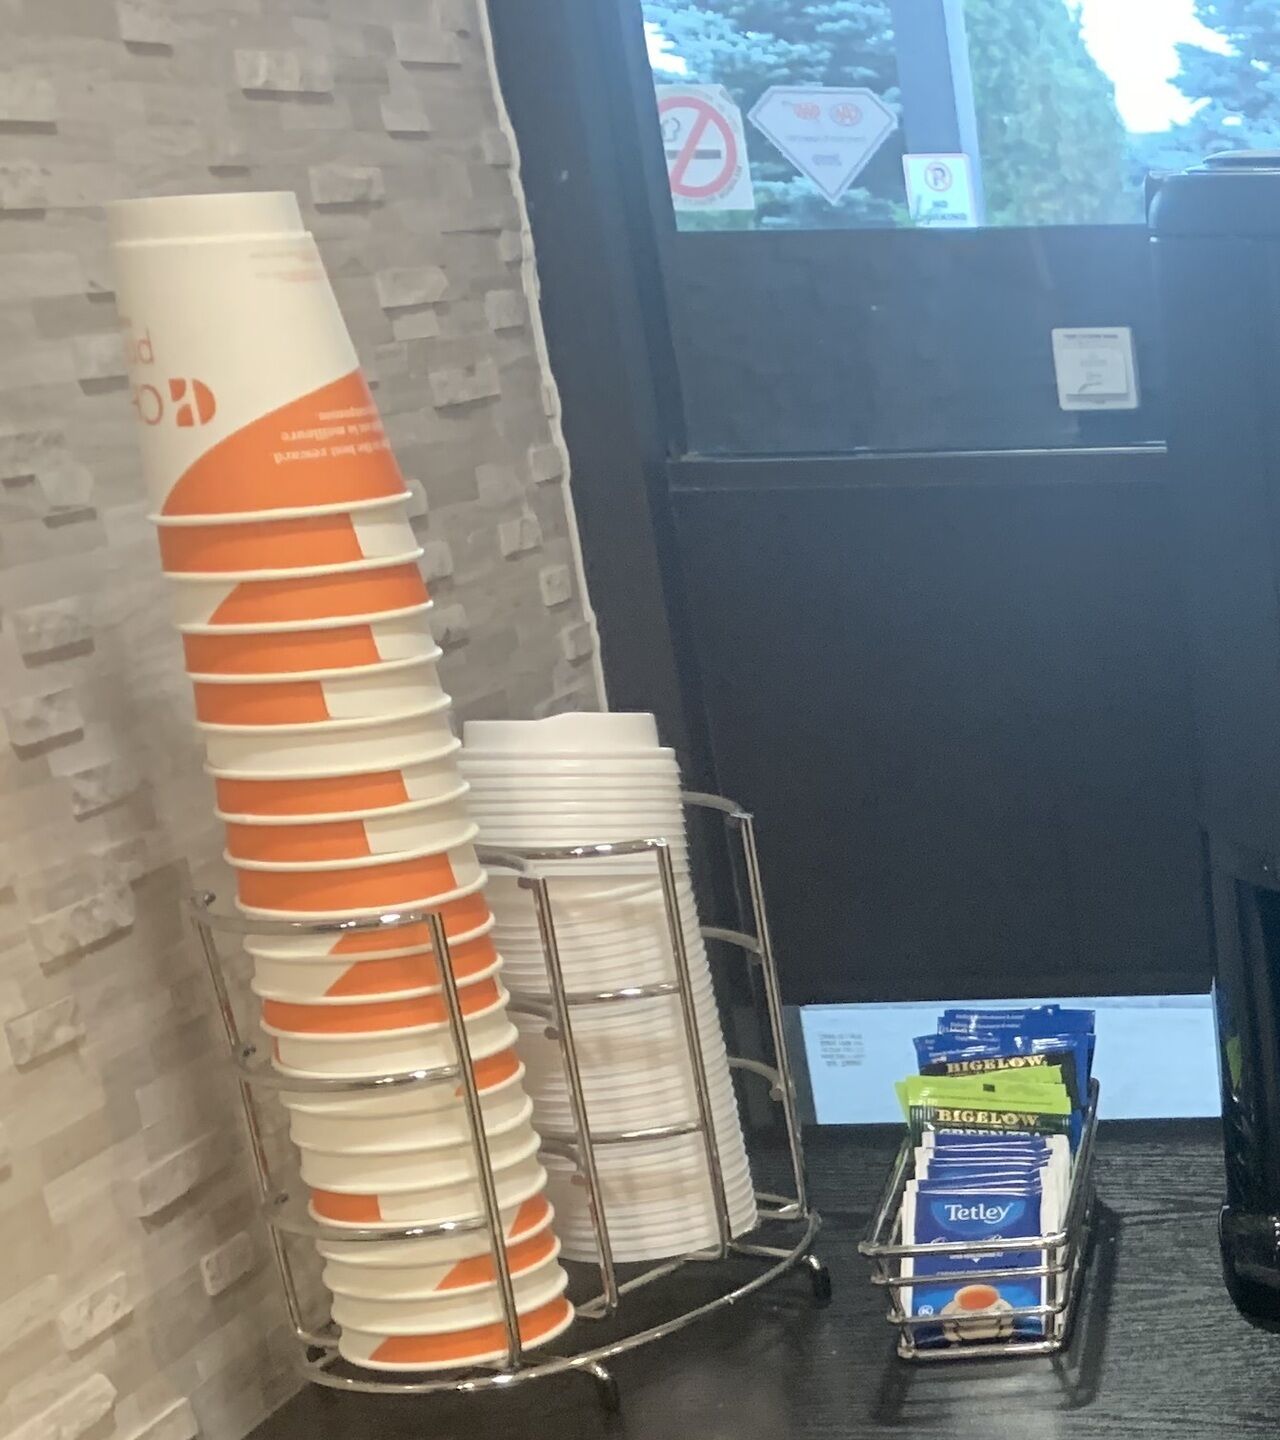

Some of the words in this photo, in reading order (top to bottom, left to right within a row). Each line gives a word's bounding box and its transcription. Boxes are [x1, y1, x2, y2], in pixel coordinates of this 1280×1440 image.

[946, 1053, 1046, 1074] BIGELOW
[935, 1108, 1039, 1127] BIGELOW
[944, 1202, 1015, 1225] Tetley
